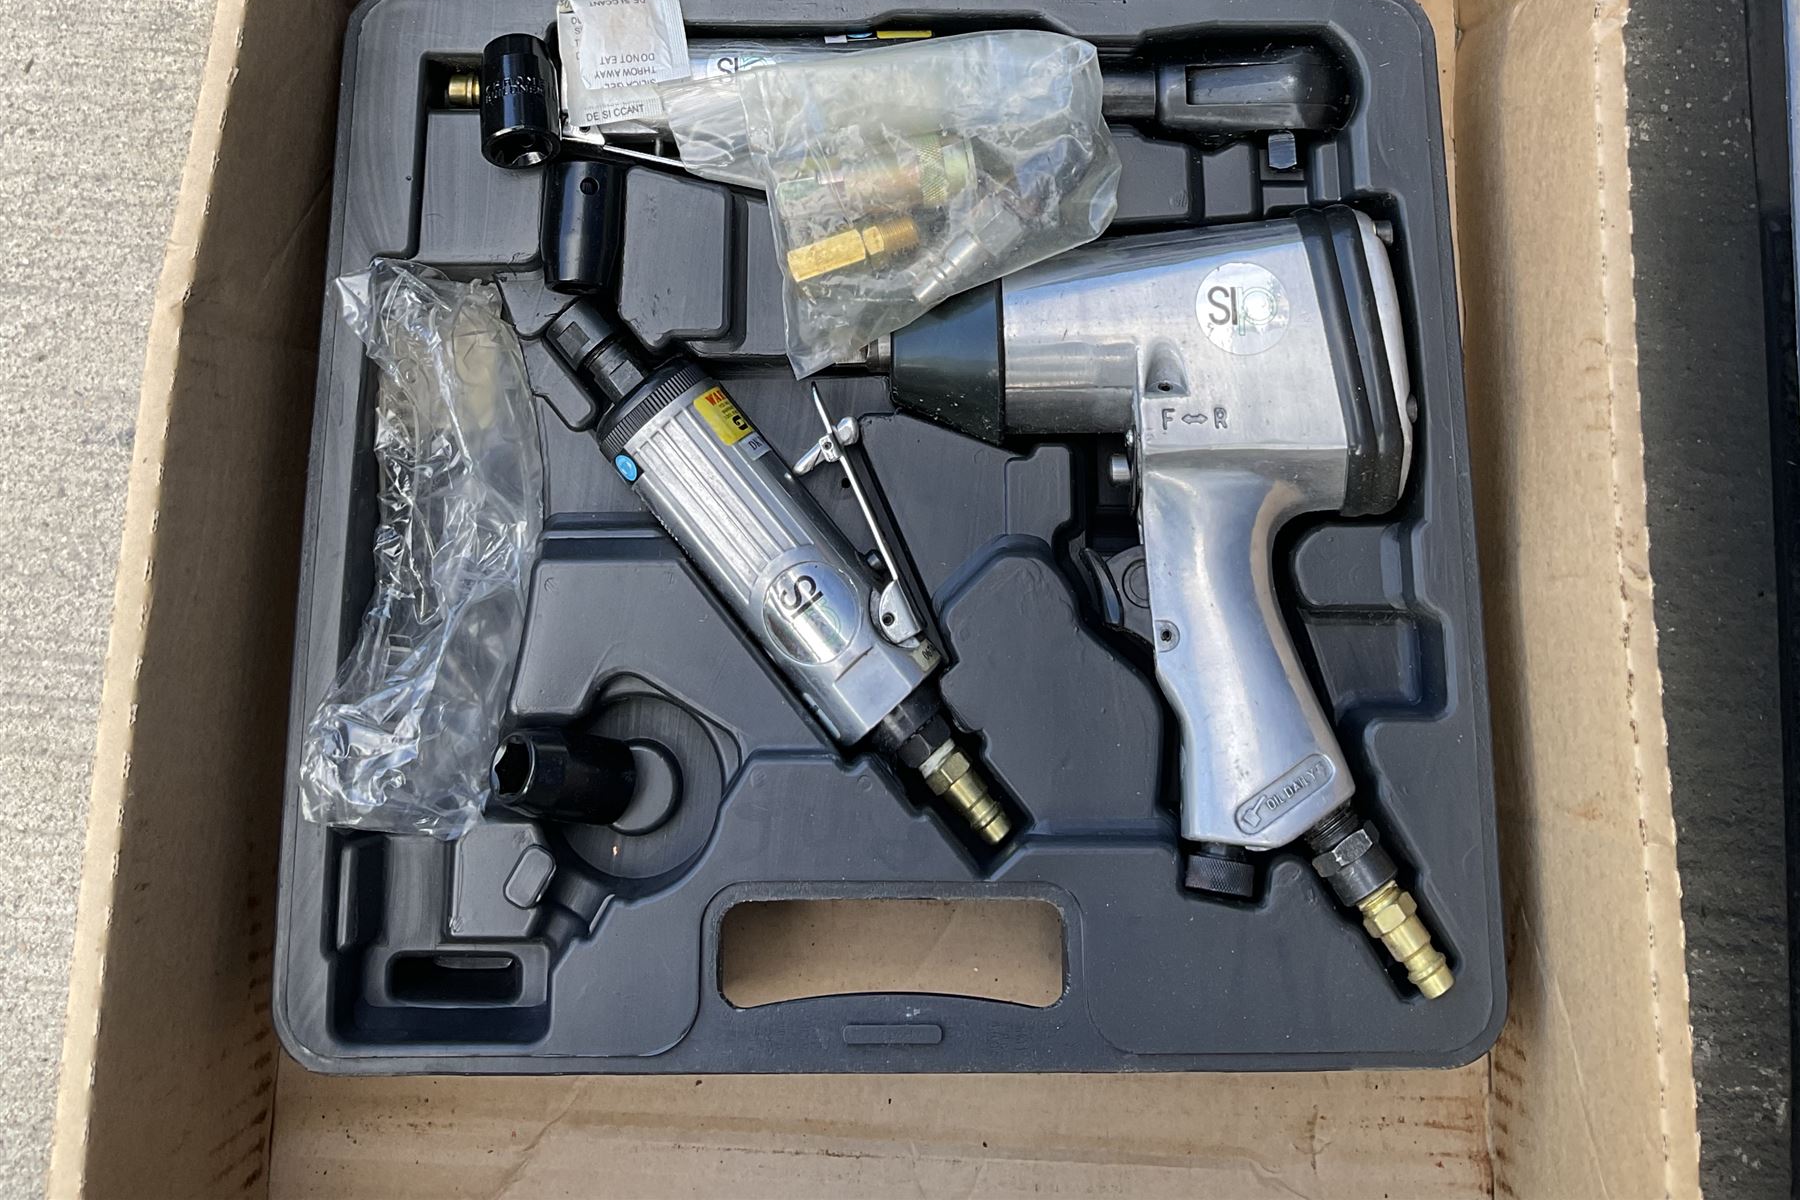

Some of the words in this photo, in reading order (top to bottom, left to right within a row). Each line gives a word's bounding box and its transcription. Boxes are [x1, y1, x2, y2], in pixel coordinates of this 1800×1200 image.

[599, 56, 618, 65] EAT
[620, 54, 639, 63] NOT
[640, 53, 655, 62] DO
[593, 68, 621, 80] AWAY
[622, 67, 657, 77] THROW
[586, 111, 599, 122] DE
[602, 109, 611, 119] SI
[613, 103, 645, 119] CCANT
[1162, 408, 1175, 431] F
[1213, 407, 1228, 430] R
[1266, 794, 1286, 810] OIL
[1283, 768, 1317, 798] DAILY
